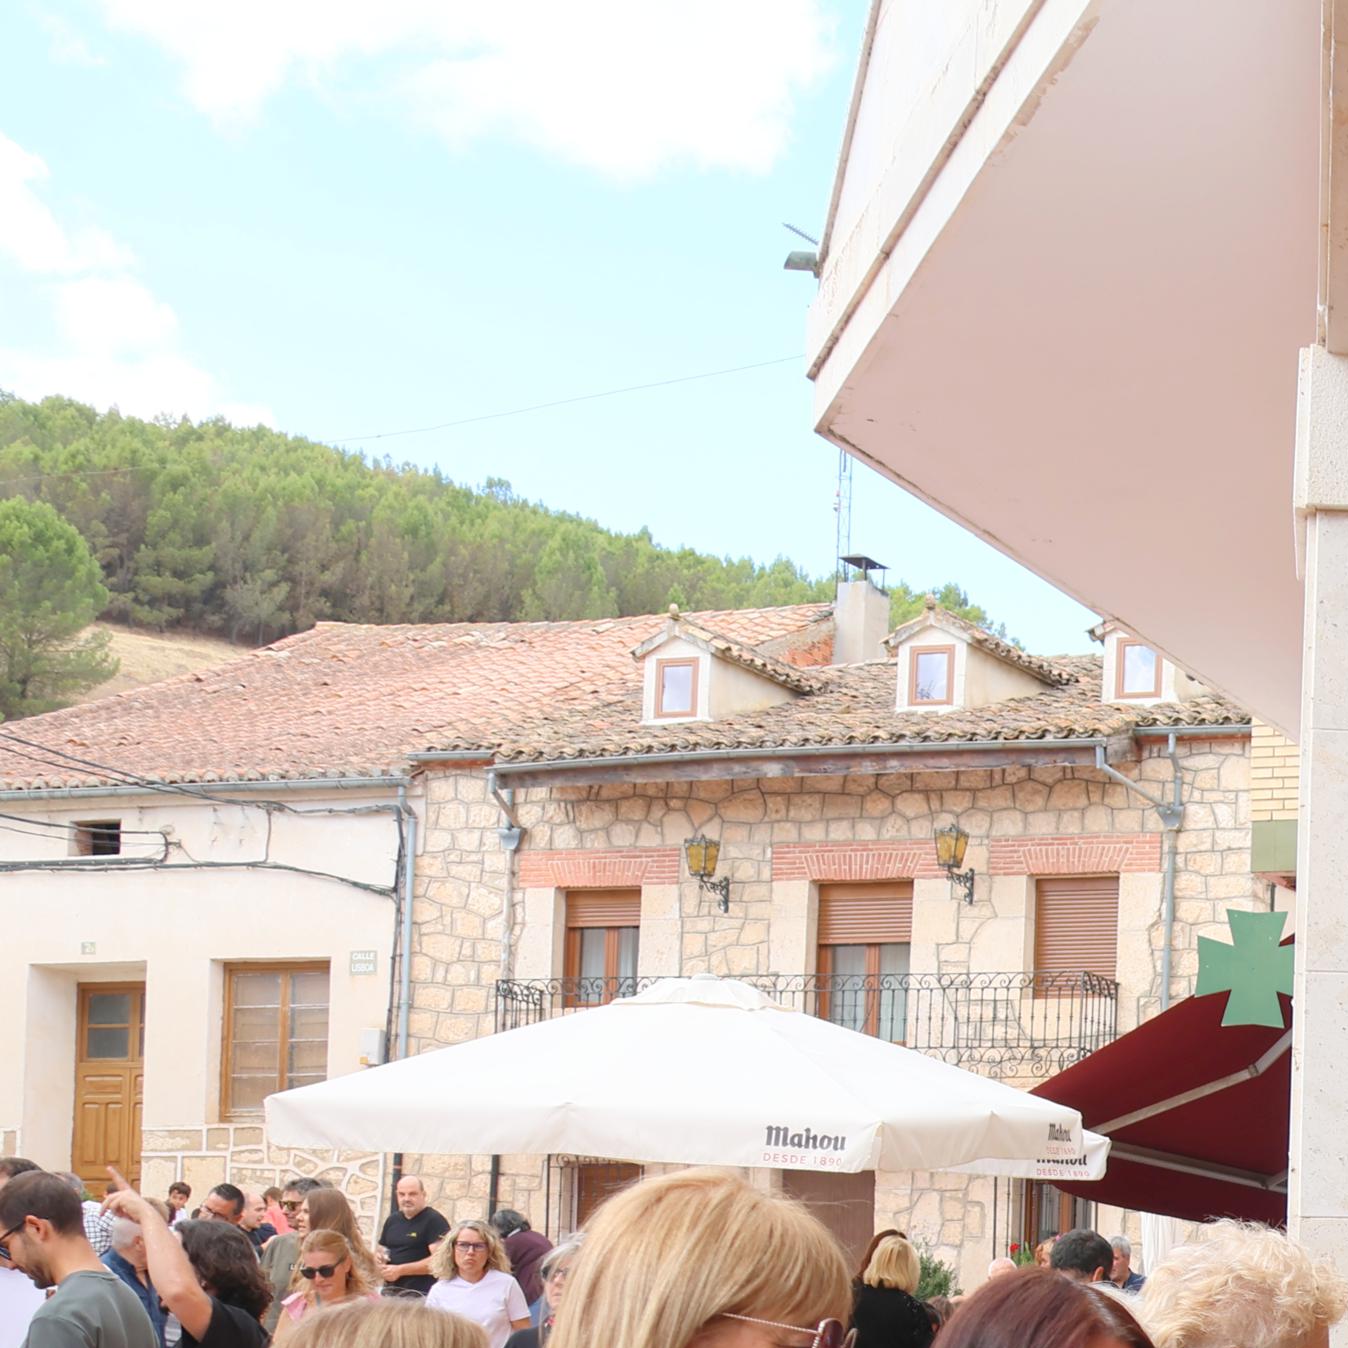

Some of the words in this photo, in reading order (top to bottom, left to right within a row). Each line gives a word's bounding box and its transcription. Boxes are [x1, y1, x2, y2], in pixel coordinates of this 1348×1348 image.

[765, 1125, 846, 1151] Mahou
[762, 1152, 807, 1164] DESDE
[814, 1156, 842, 1166] 1890
